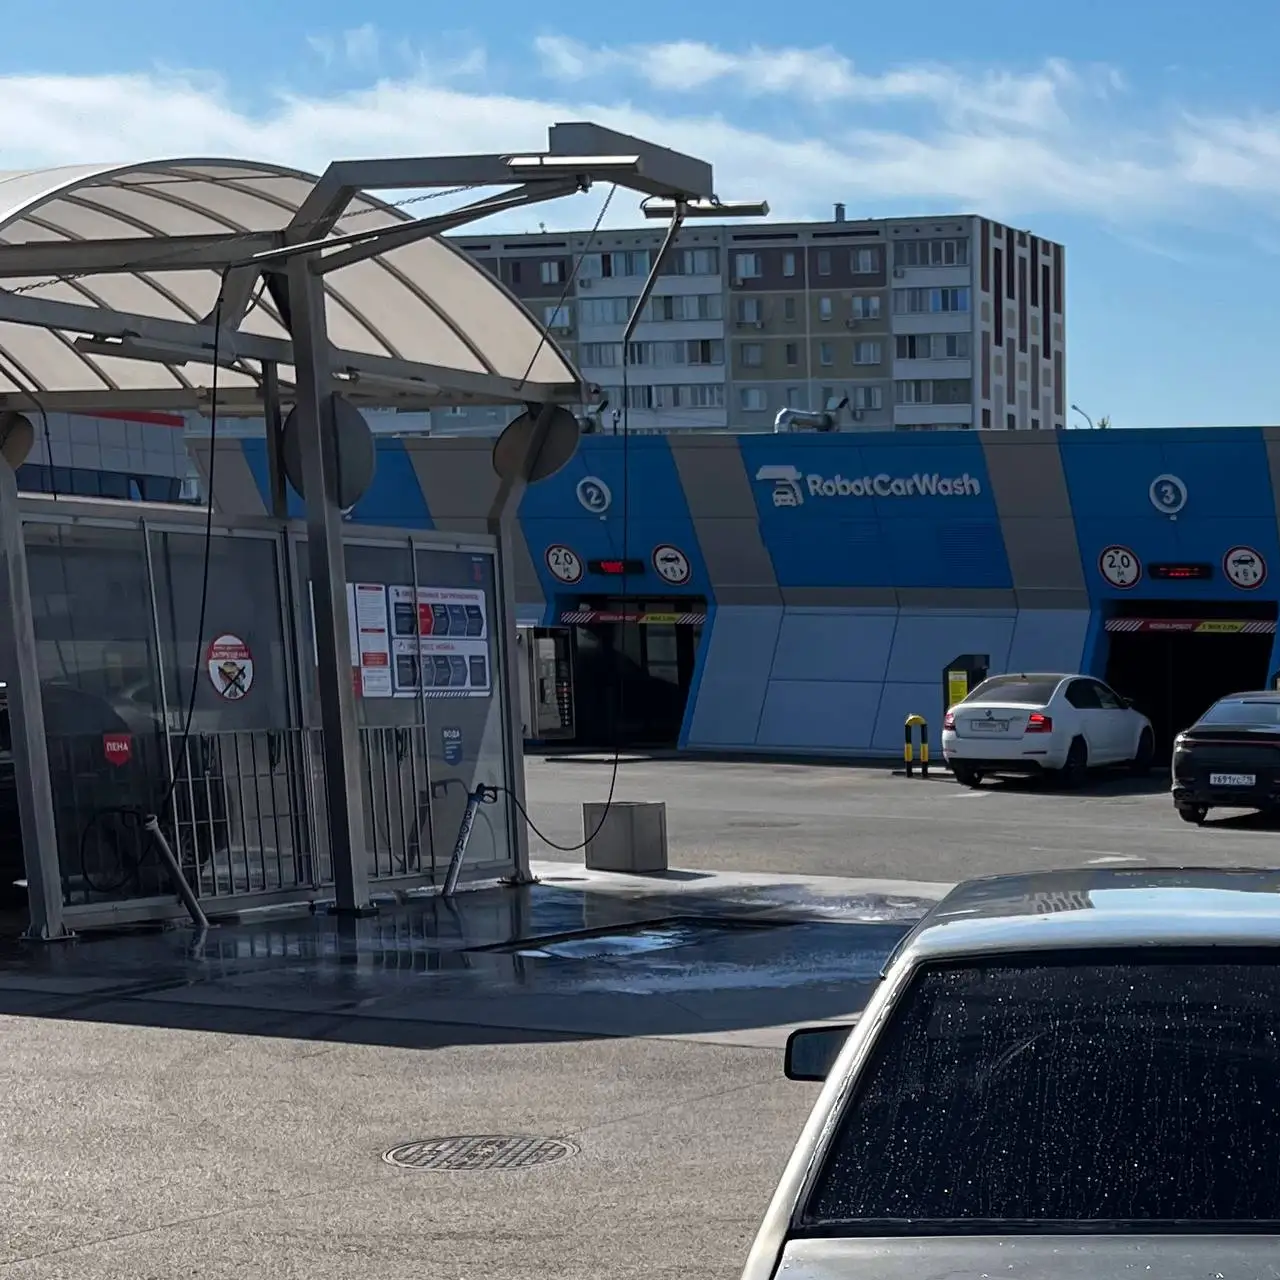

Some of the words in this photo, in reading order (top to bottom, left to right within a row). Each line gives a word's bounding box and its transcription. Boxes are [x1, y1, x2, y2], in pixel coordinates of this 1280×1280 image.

[806, 473, 981, 497] RobotCarWash
[1160, 483, 1176, 504] 3
[586, 487, 601, 505] 2
[106, 741, 129, 752] ПЕНА
